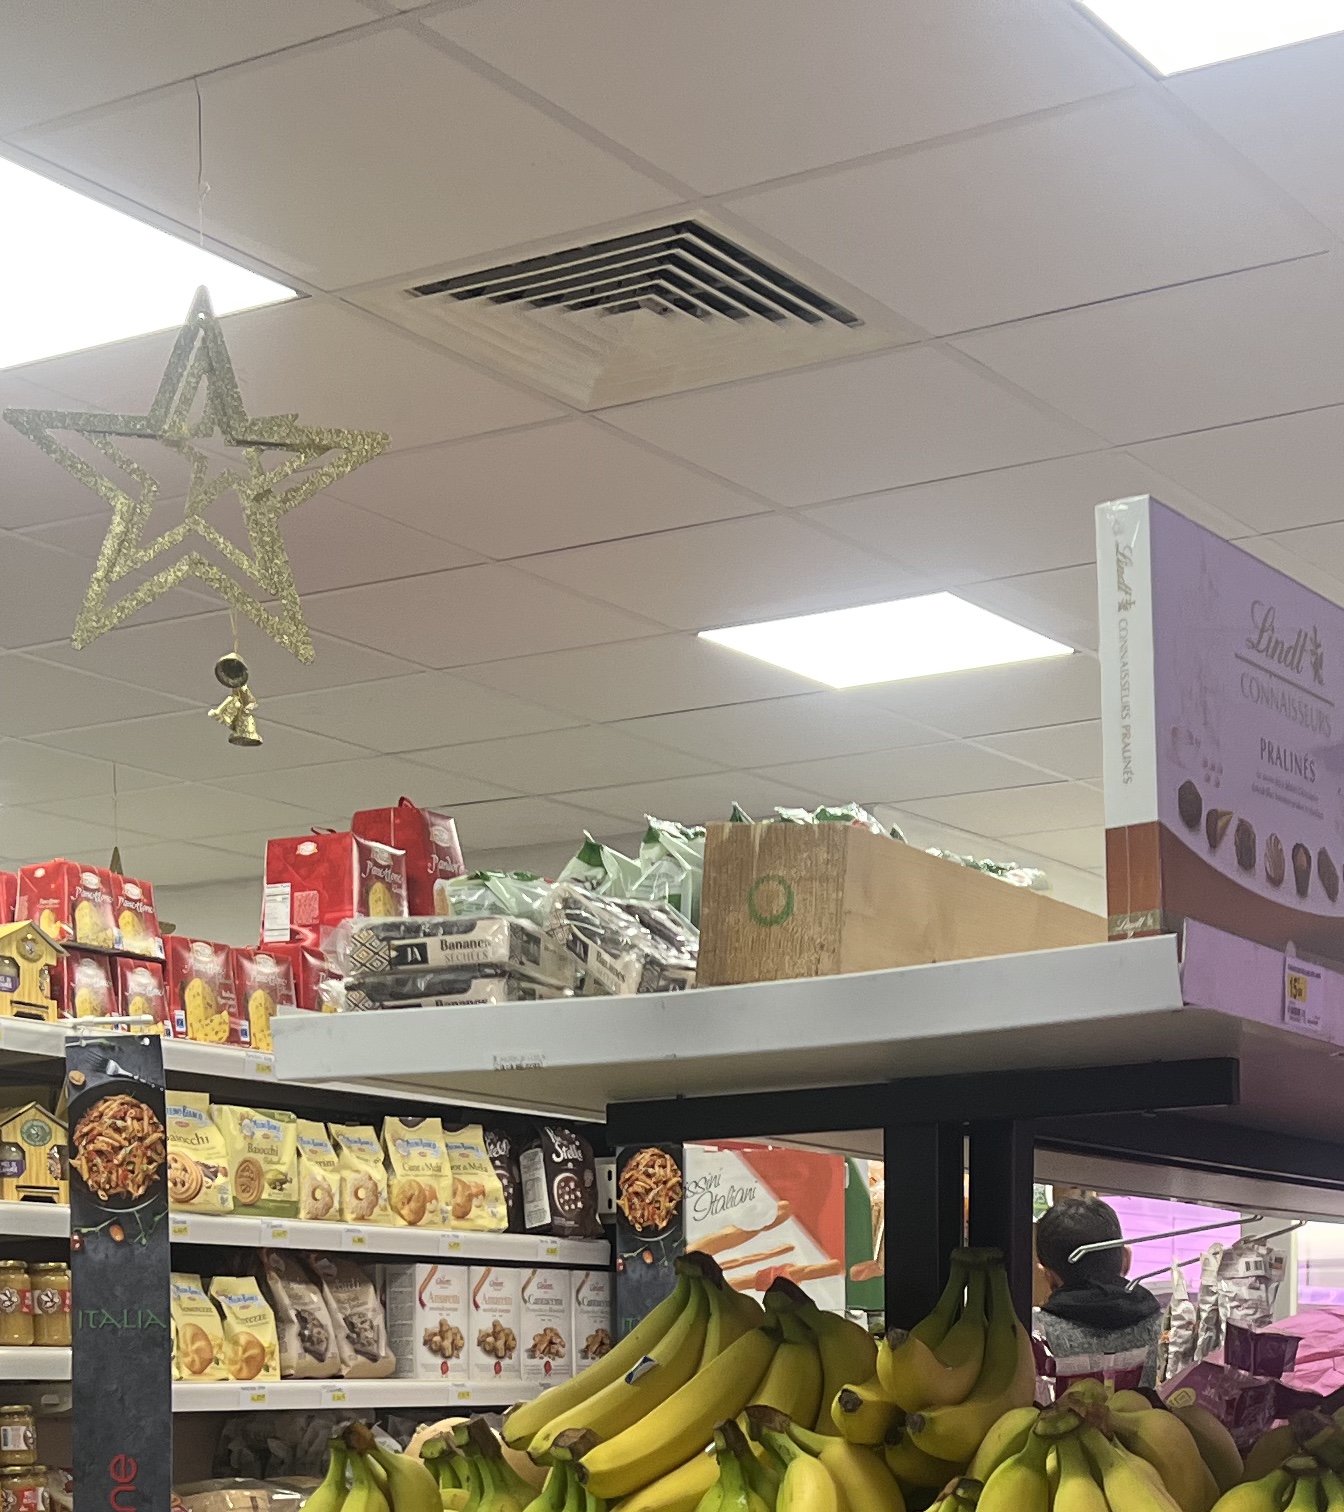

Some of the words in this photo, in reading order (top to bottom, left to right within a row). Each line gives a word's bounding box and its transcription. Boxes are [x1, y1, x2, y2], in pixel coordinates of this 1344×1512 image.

[1246, 600, 1309, 674] Lindt
[1240, 671, 1332, 738] CONNAISSEURS
[1260, 736, 1316, 784] PRALINÉS
[693, 1180, 759, 1222] Italiani
[78, 1308, 166, 1330] ITALIA
